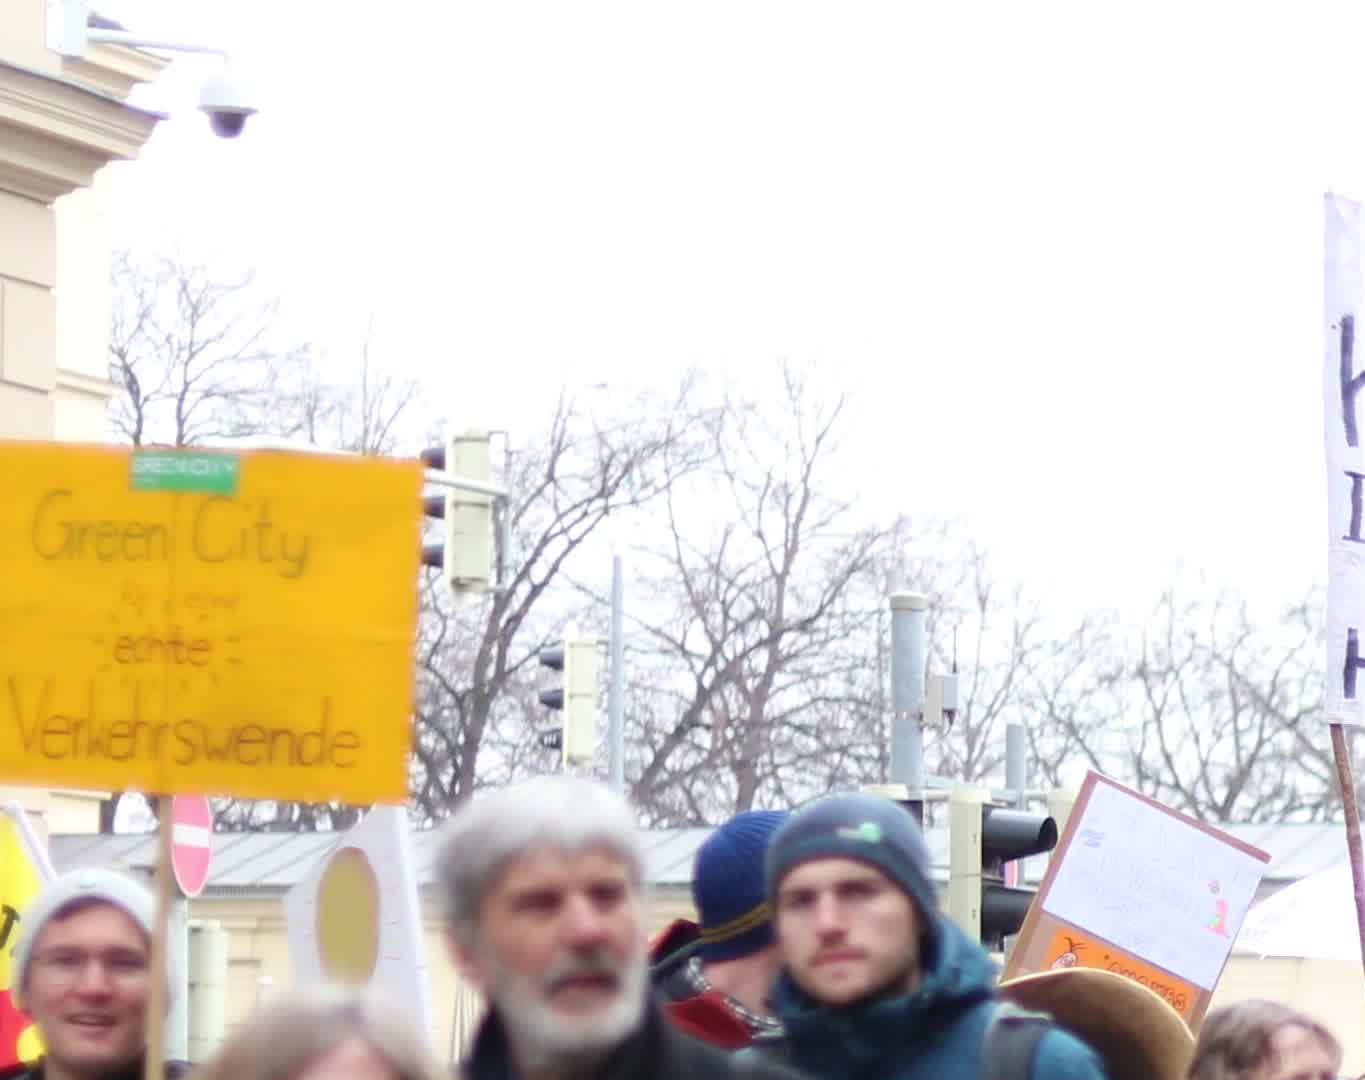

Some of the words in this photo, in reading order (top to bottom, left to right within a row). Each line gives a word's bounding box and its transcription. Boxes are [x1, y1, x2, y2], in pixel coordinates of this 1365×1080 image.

[32, 489, 170, 563] Green
[192, 492, 314, 580] City
[7, 675, 362, 769] Verkehrswende
